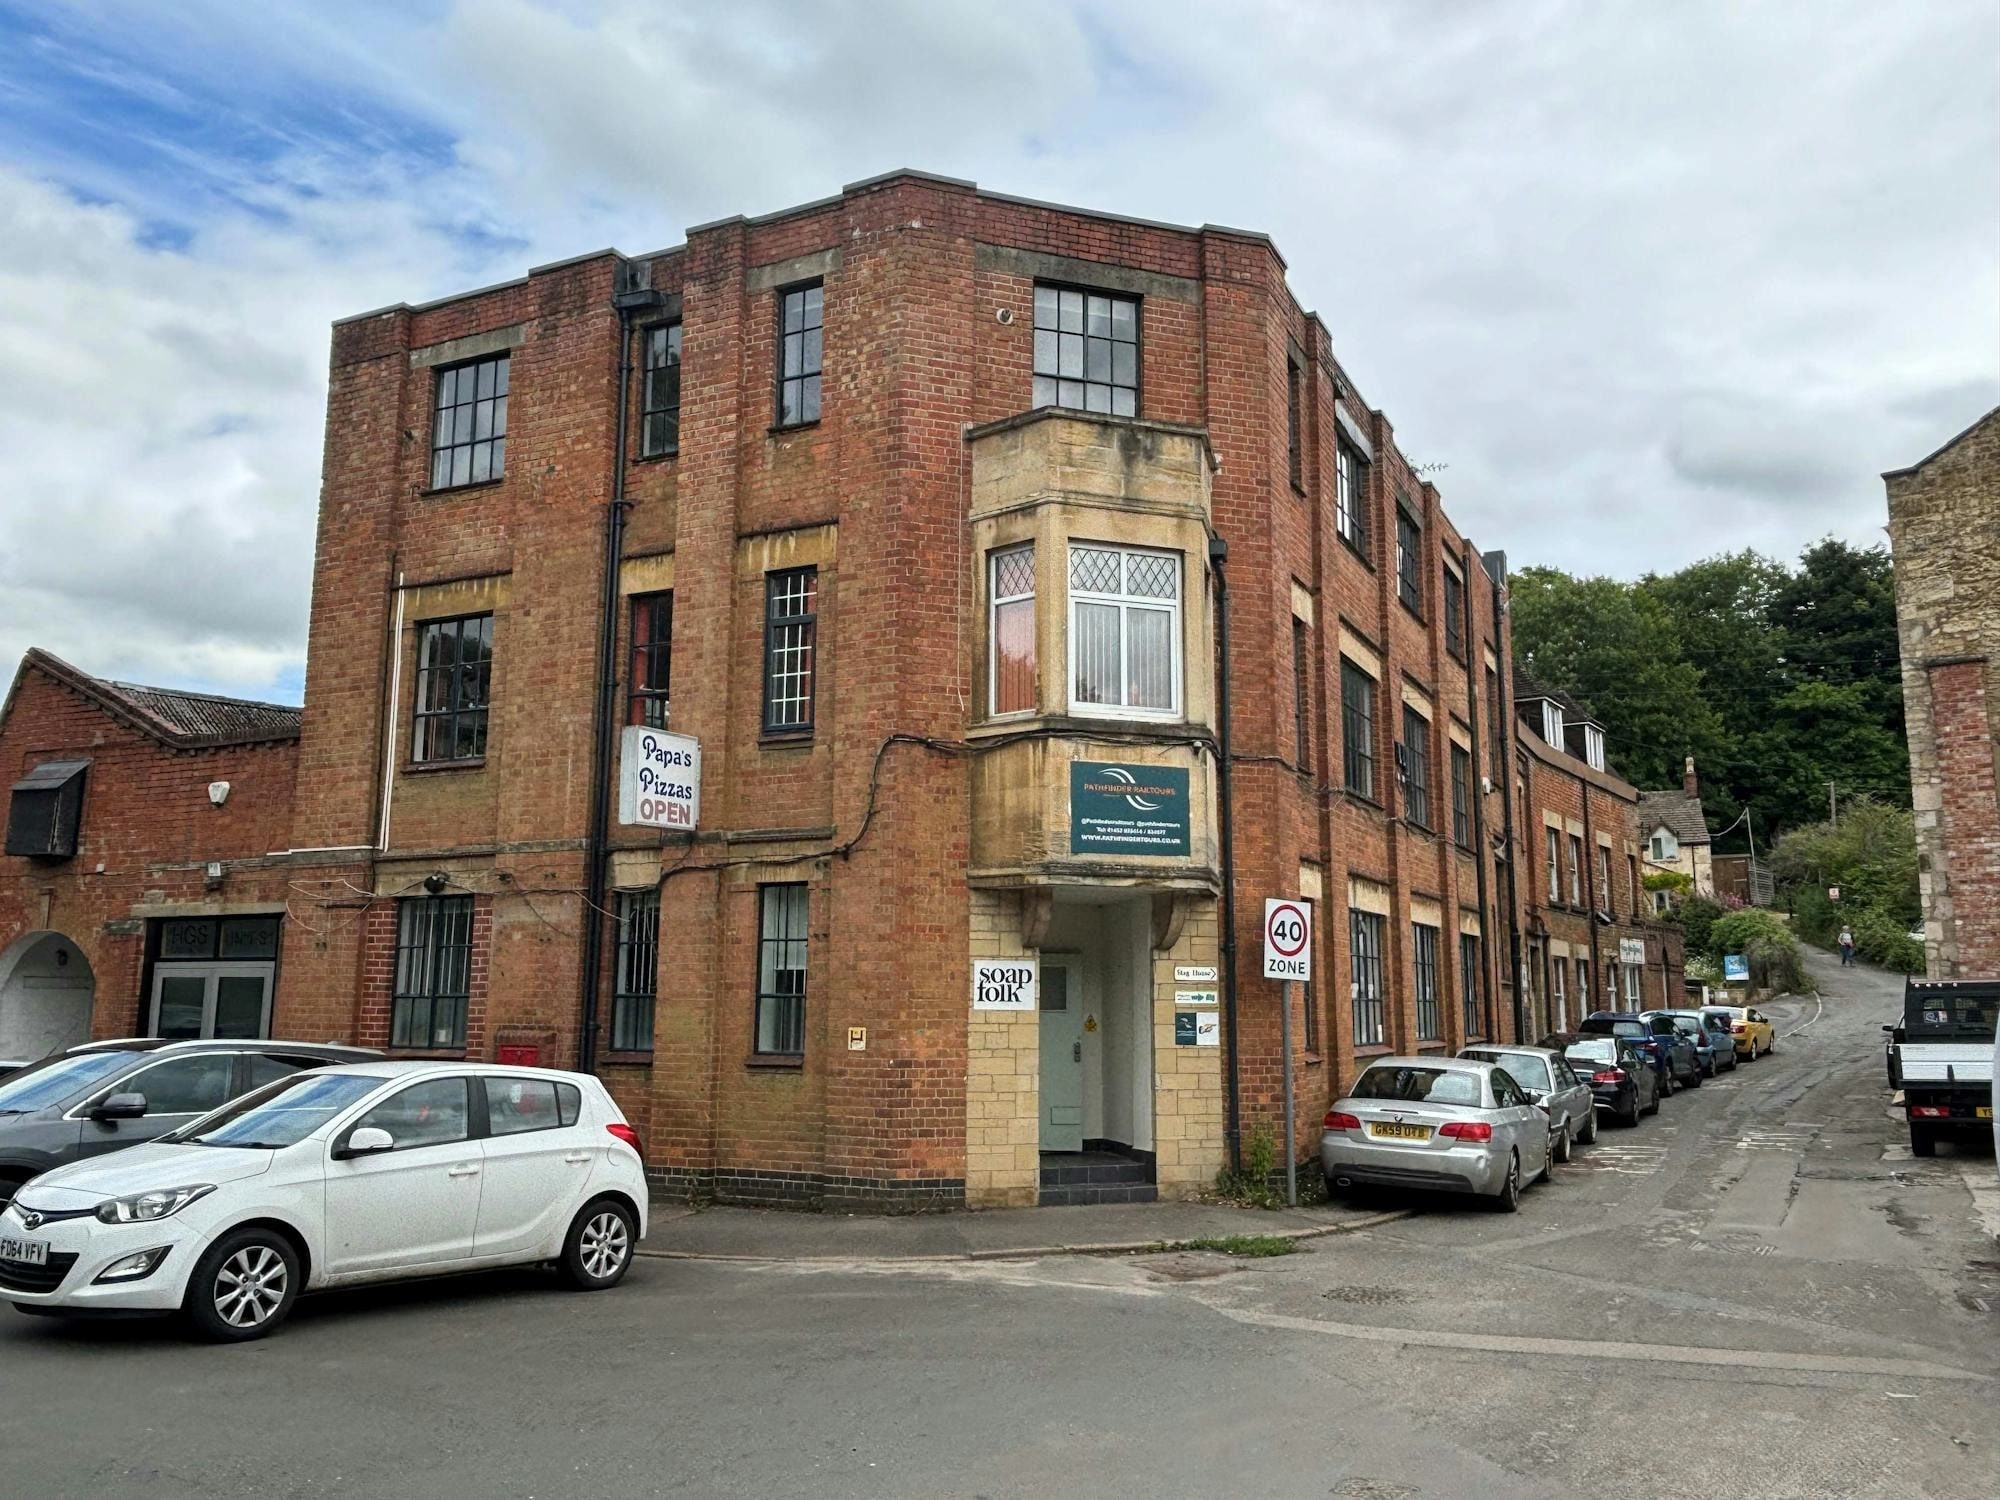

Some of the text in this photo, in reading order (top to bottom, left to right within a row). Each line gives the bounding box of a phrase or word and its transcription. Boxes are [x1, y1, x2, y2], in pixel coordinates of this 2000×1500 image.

[642, 735, 692, 768] Papa's
[639, 767, 692, 799] Pizzas
[1084, 784, 1132, 793] PATHFINDER
[1134, 786, 1176, 795] RAILTOURS
[640, 799, 691, 825] OPEN
[1273, 920, 1303, 942] 40
[1268, 958, 1306, 974] ZONE
[979, 967, 1033, 989] soap
[977, 979, 1022, 1003] folk
